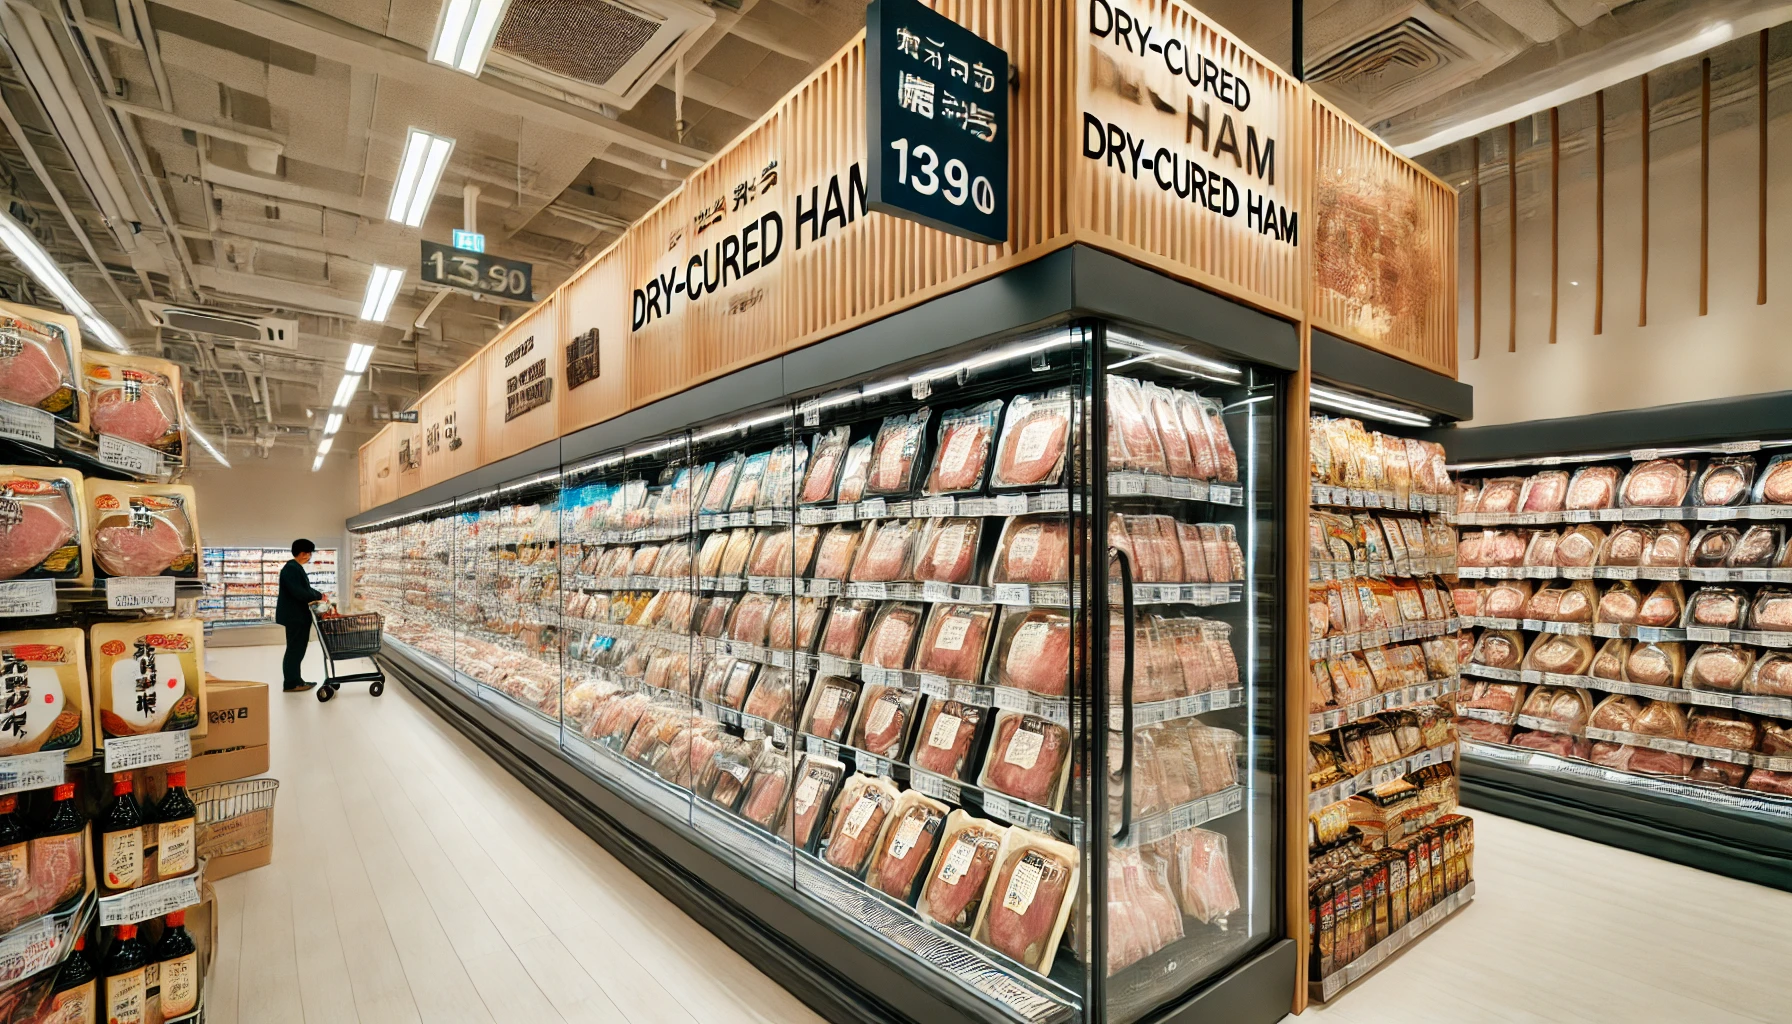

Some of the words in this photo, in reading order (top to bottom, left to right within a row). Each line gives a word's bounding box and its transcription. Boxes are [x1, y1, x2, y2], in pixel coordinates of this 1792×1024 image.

[1090, 0, 1250, 112] DRY-CURED
[1083, 111, 1239, 218] DRY-CURED
[1247, 188, 1298, 247] HAM
[1186, 94, 1275, 186] HAM
[632, 210, 783, 332] DRY-CURED
